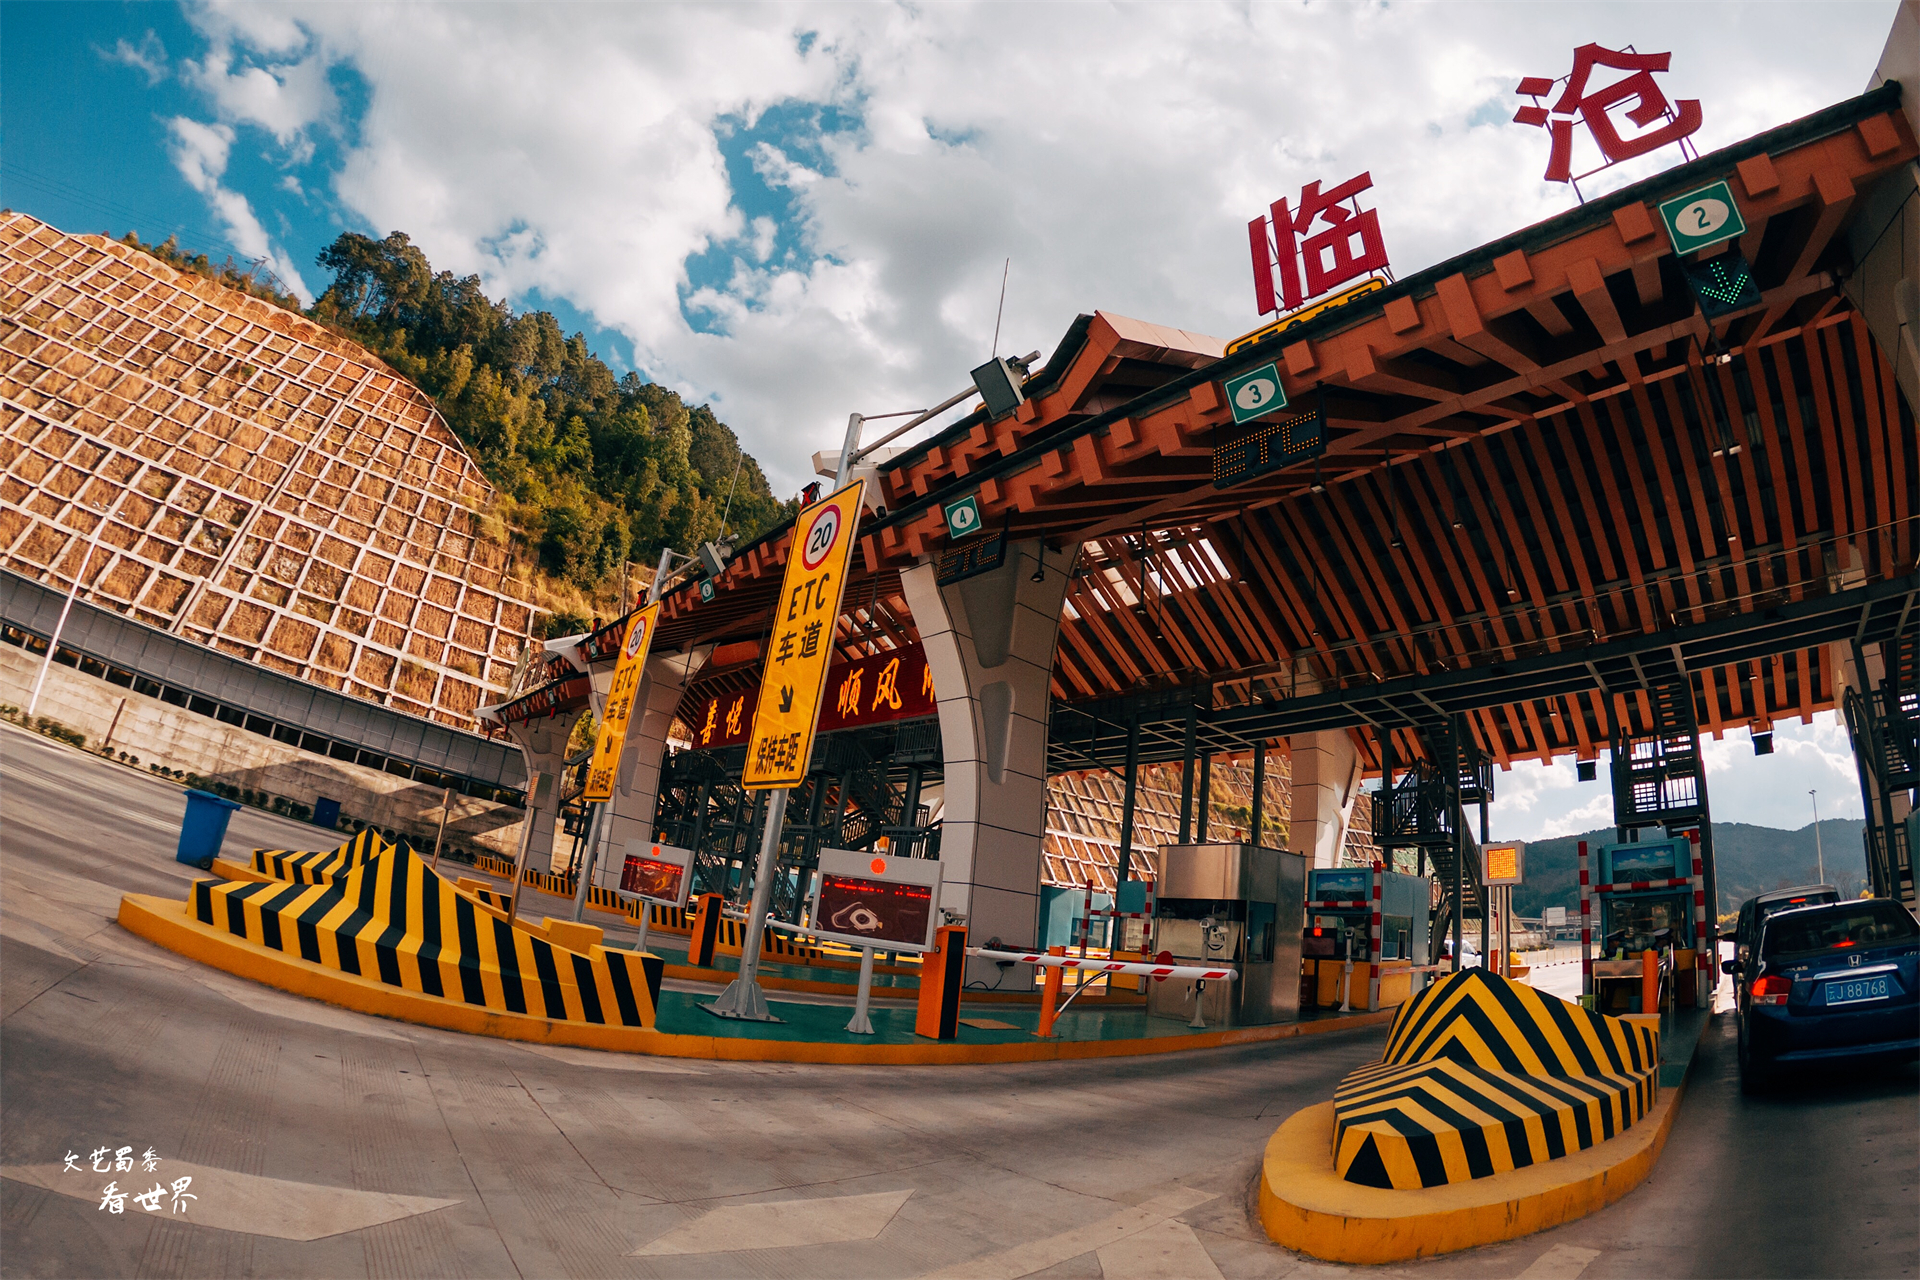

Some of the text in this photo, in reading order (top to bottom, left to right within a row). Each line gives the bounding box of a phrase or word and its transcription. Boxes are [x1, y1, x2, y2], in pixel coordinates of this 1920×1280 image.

[1248, 42, 1702, 316] 临沧
[1693, 206, 1711, 229] 2
[1248, 384, 1262, 404] 3
[1213, 410, 1319, 481] ETC
[959, 509, 967, 525] 4
[809, 521, 832, 555] 20
[937, 532, 1000, 580] ETC
[787, 572, 830, 622] ETC
[629, 628, 642, 648] 20
[775, 618, 823, 666] 车道
[614, 663, 637, 693] ETC
[753, 731, 802, 776] 保持车距
